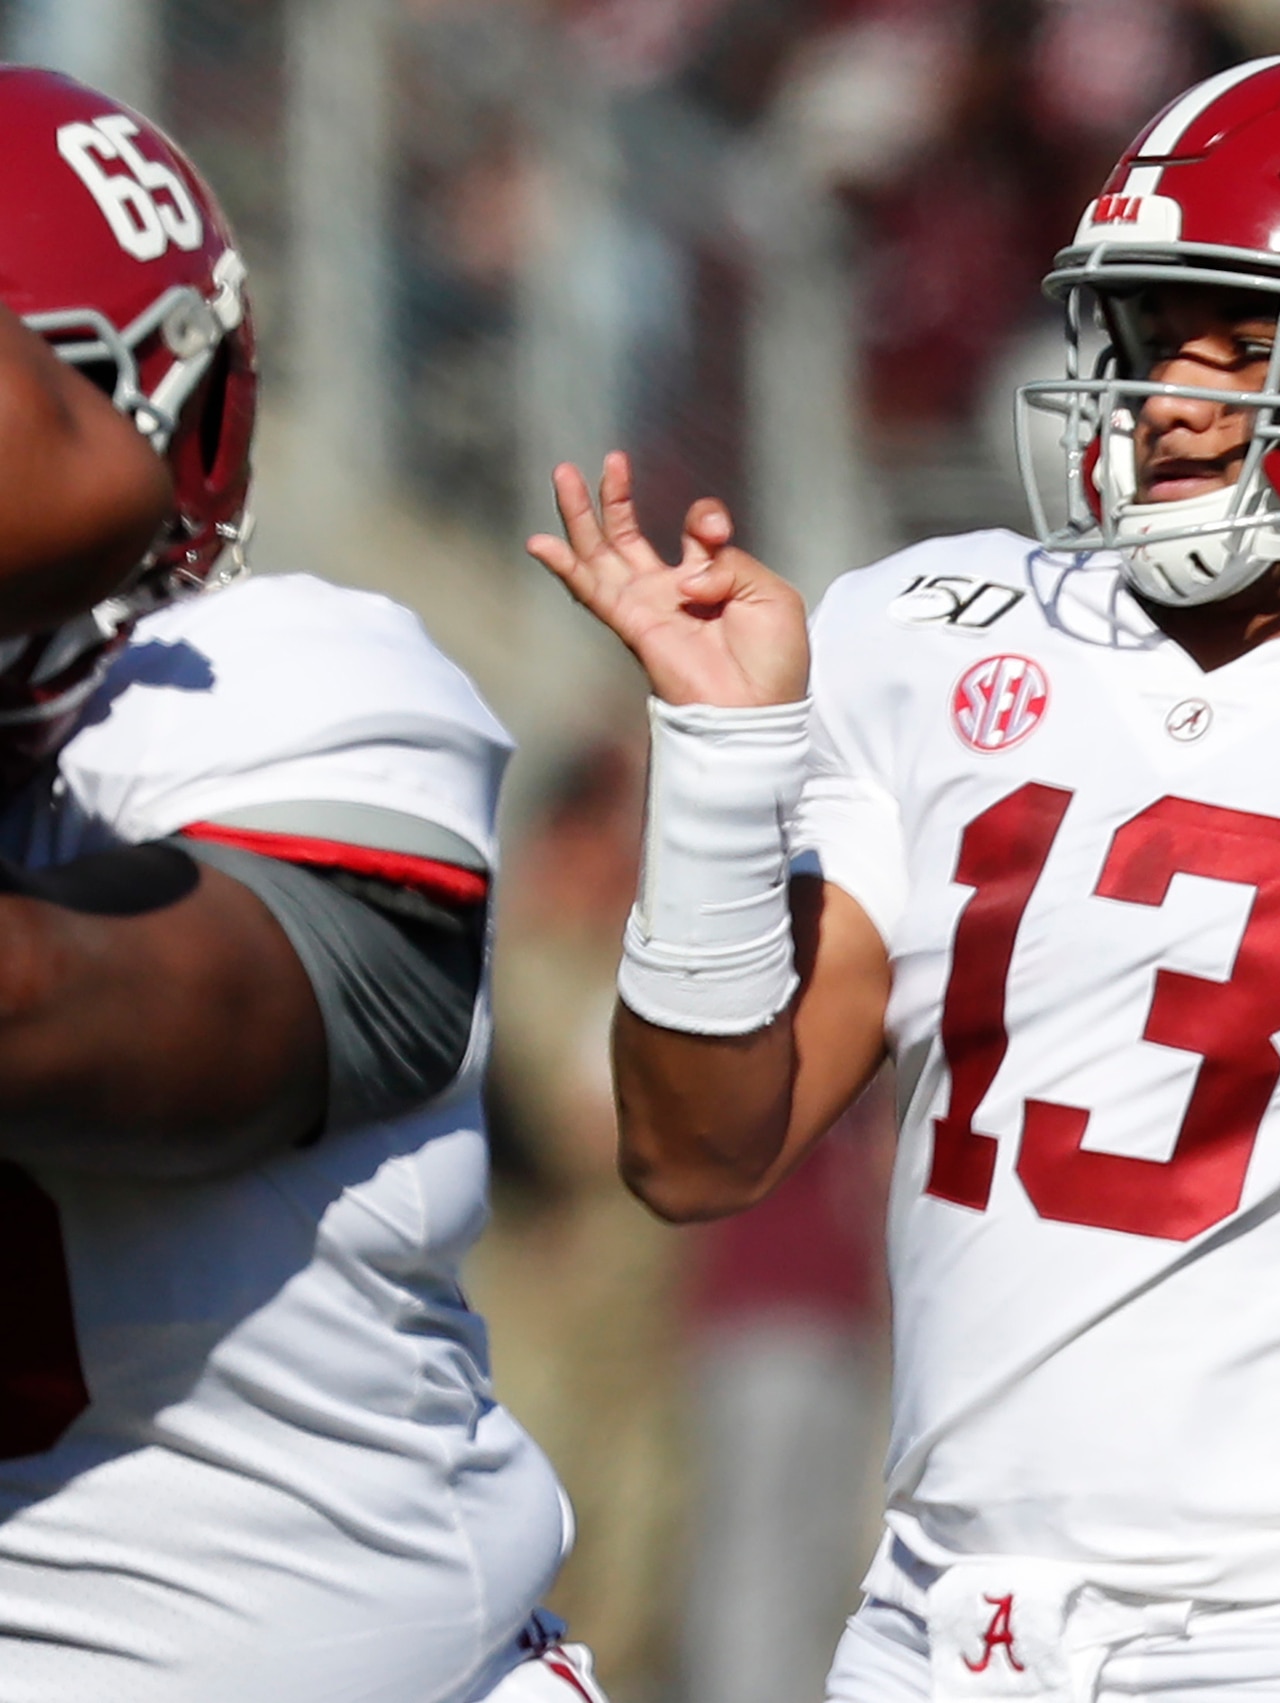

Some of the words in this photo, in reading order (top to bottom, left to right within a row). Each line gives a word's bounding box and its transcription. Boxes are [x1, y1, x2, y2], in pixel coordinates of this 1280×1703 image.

[56, 113, 204, 262] 65
[898, 574, 1026, 630] 150
[953, 653, 1050, 751] SEC
[962, 1593, 1025, 1672] A
